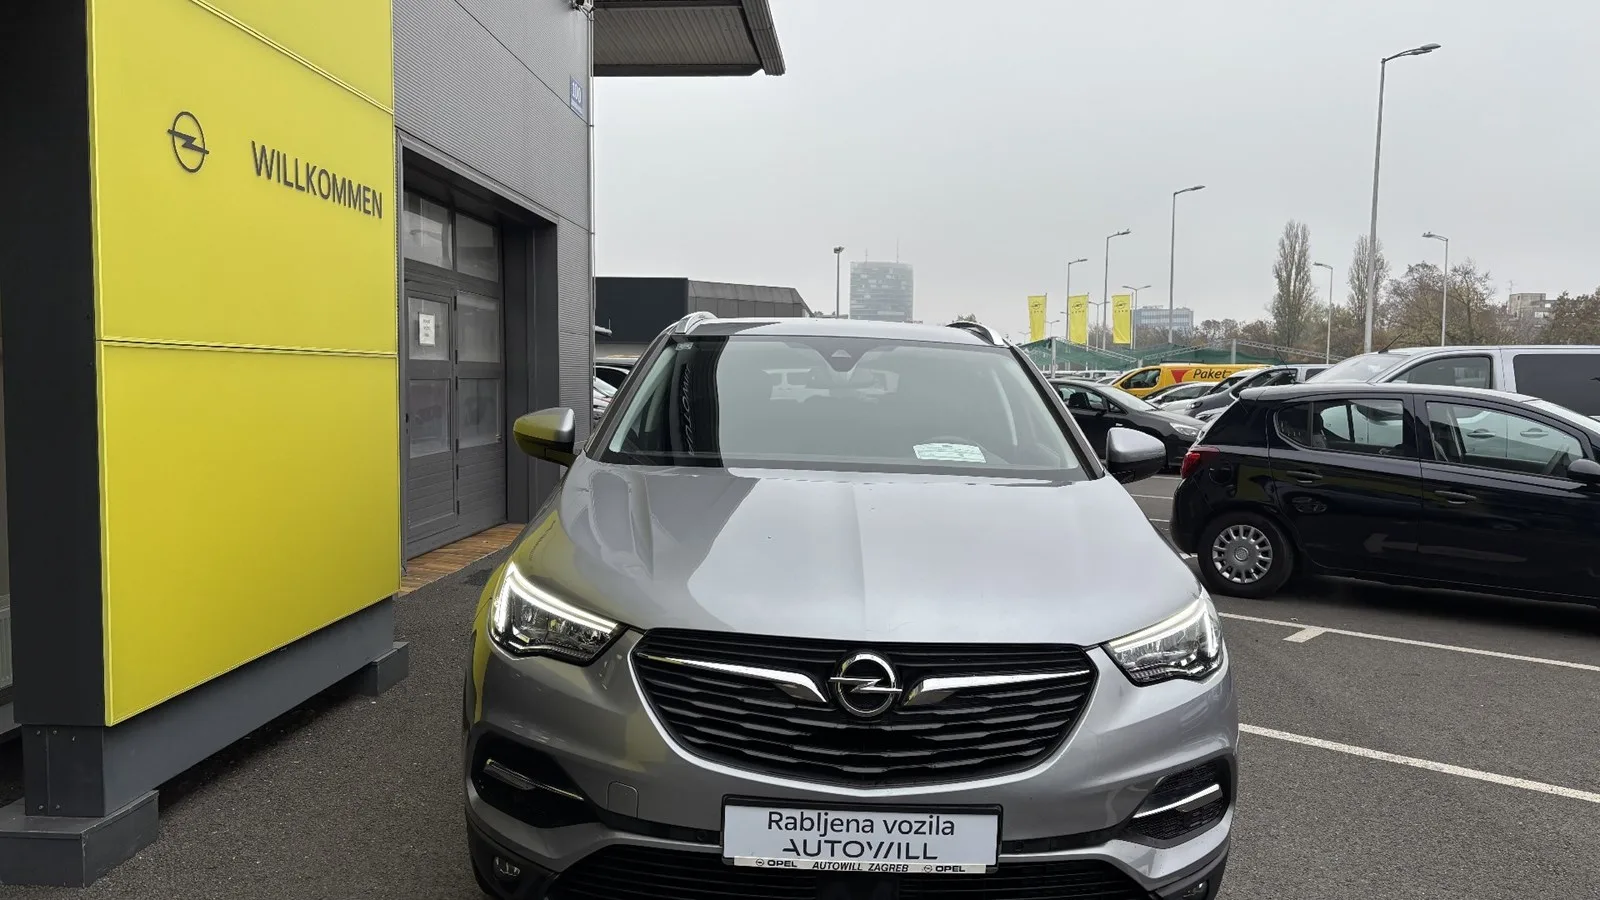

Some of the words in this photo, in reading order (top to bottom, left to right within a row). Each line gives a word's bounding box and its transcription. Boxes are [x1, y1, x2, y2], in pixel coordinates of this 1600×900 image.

[251, 140, 382, 219] WILLKOMMEN
[1193, 368, 1227, 379] Paket
[767, 811, 874, 837] Rabljena
[882, 814, 955, 836] vozila
[782, 838, 938, 860] AUTOWILL
[767, 859, 798, 868] OPEL
[812, 861, 863, 871] AUTOWILL
[868, 863, 909, 873] ZAGREB
[935, 865, 966, 873] OPEL
